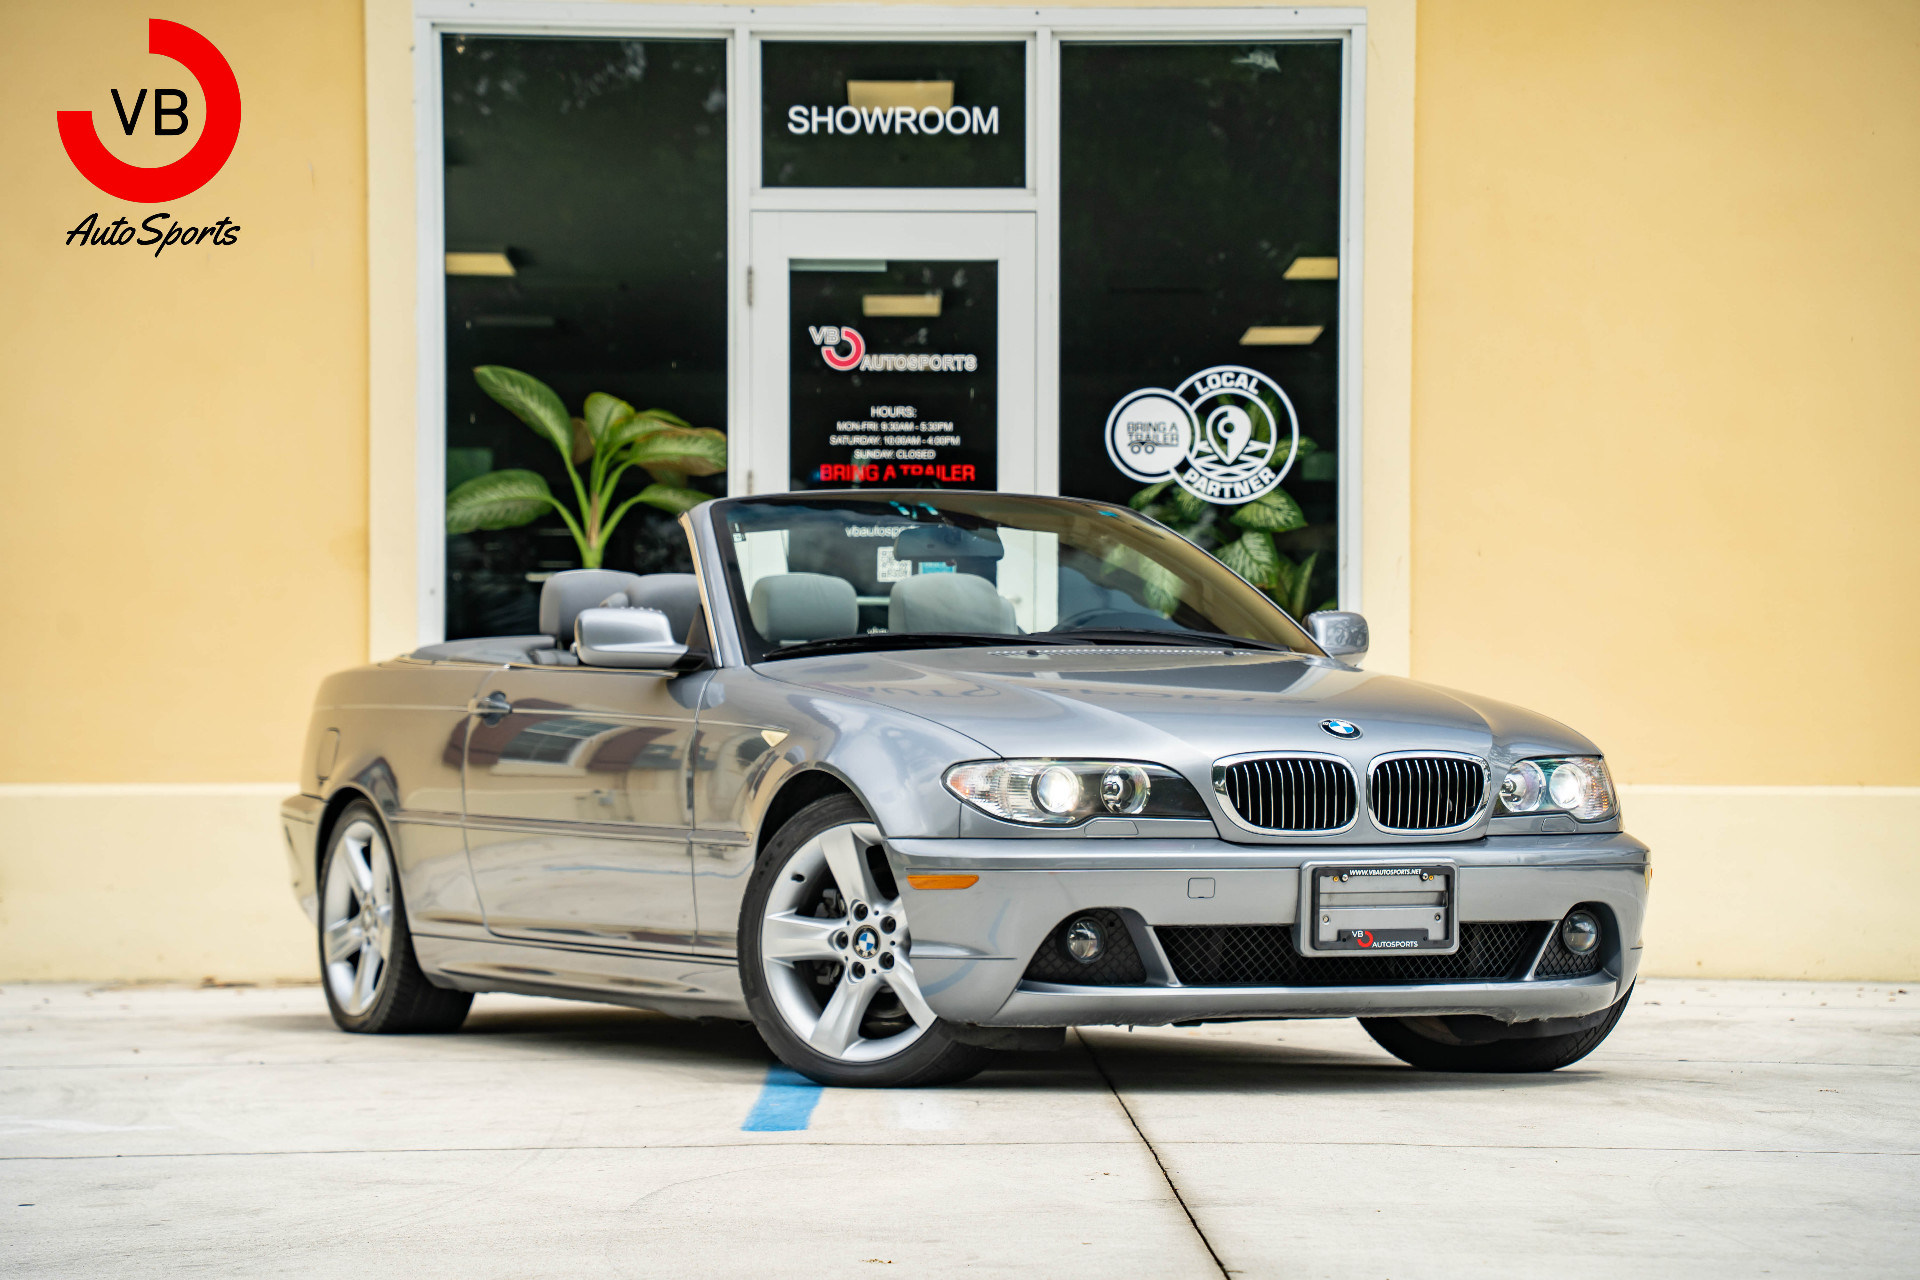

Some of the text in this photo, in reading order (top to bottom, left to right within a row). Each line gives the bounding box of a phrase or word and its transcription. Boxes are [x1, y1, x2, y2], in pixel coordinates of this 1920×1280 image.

[787, 104, 999, 135] SHOWROOM
[808, 325, 841, 345] VB
[859, 353, 978, 372] AUTOSPORTS
[1193, 372, 1260, 396] LOCAL
[870, 405, 917, 418] HOURS:
[1127, 421, 1178, 433] BRING A
[1127, 432, 1179, 443] TRAILER
[896, 448, 936, 460] CLOSED
[819, 464, 880, 482] BRING
[882, 464, 897, 482] A
[1183, 467, 1276, 498] PARTNER
[1351, 930, 1364, 938] VB
[1372, 940, 1419, 948] AUTOSPORTS
